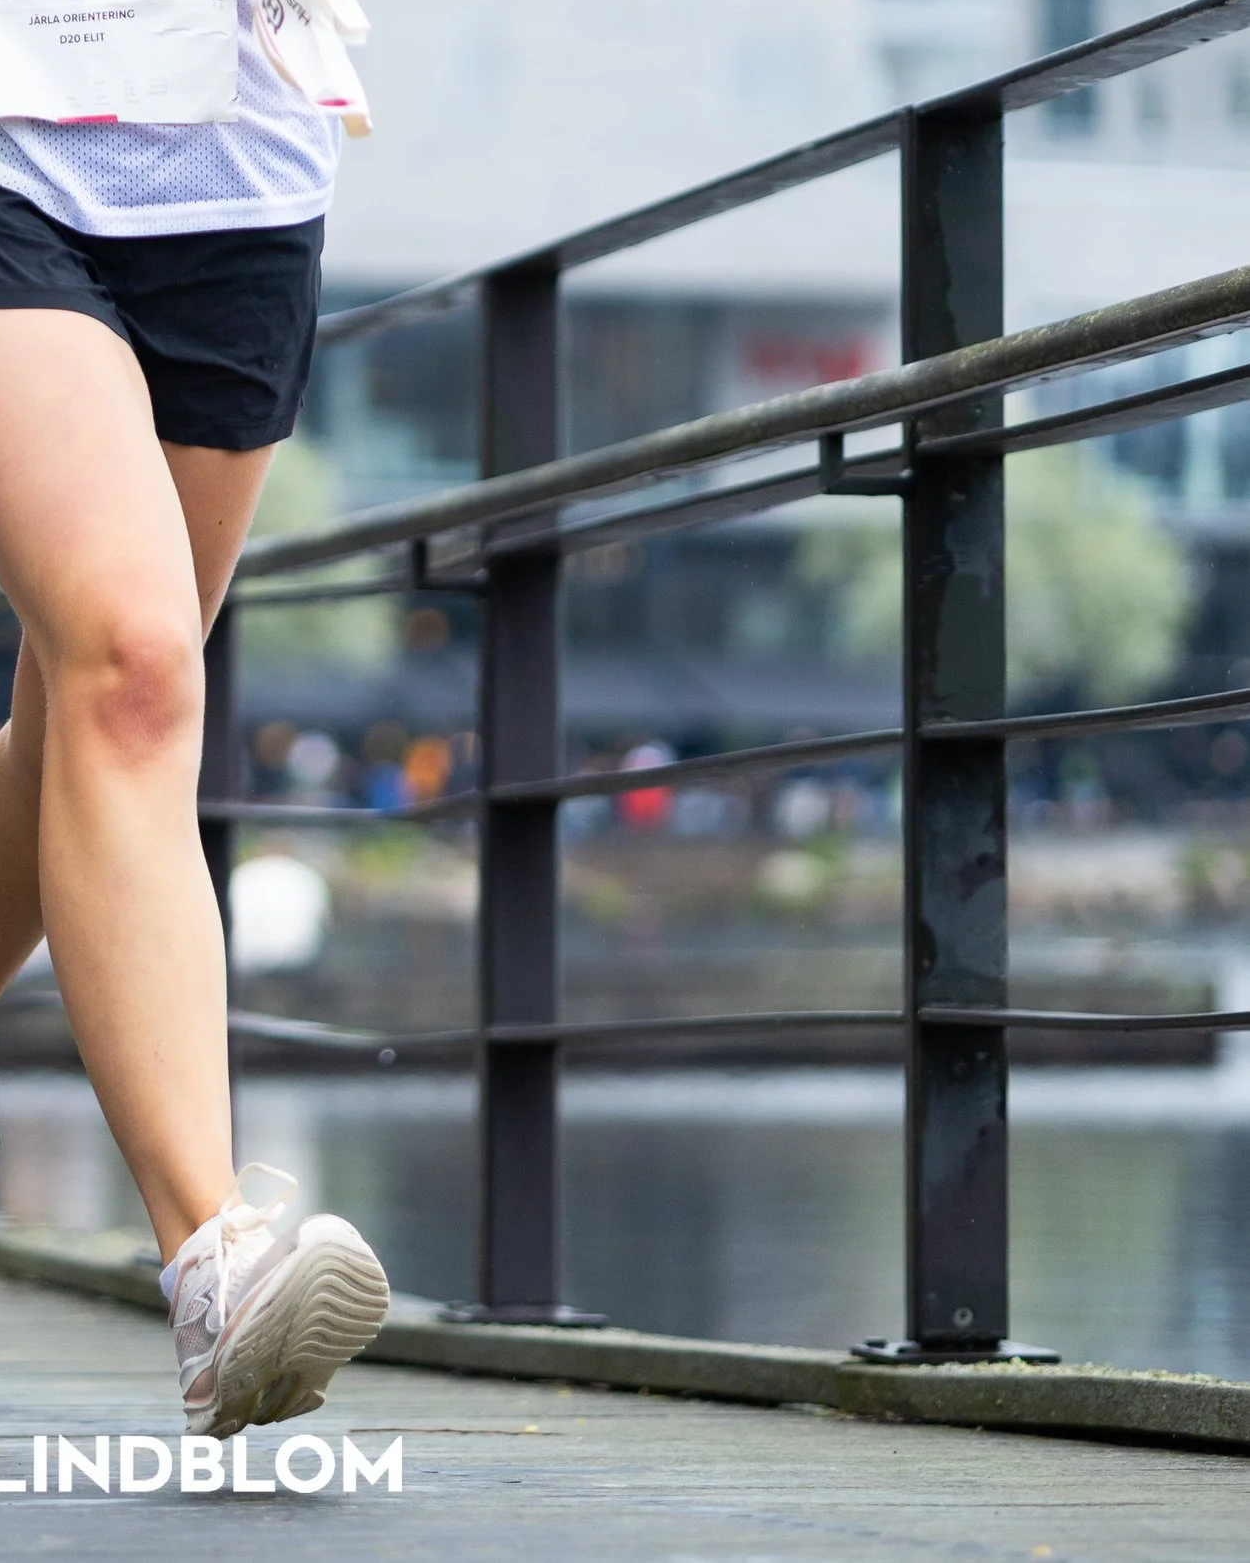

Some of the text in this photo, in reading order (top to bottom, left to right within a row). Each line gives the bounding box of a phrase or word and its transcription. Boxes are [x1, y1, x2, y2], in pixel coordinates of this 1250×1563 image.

[28, 9, 136, 26] JÄRLA ORIENTERING
[59, 32, 106, 44] D20 ELIT
